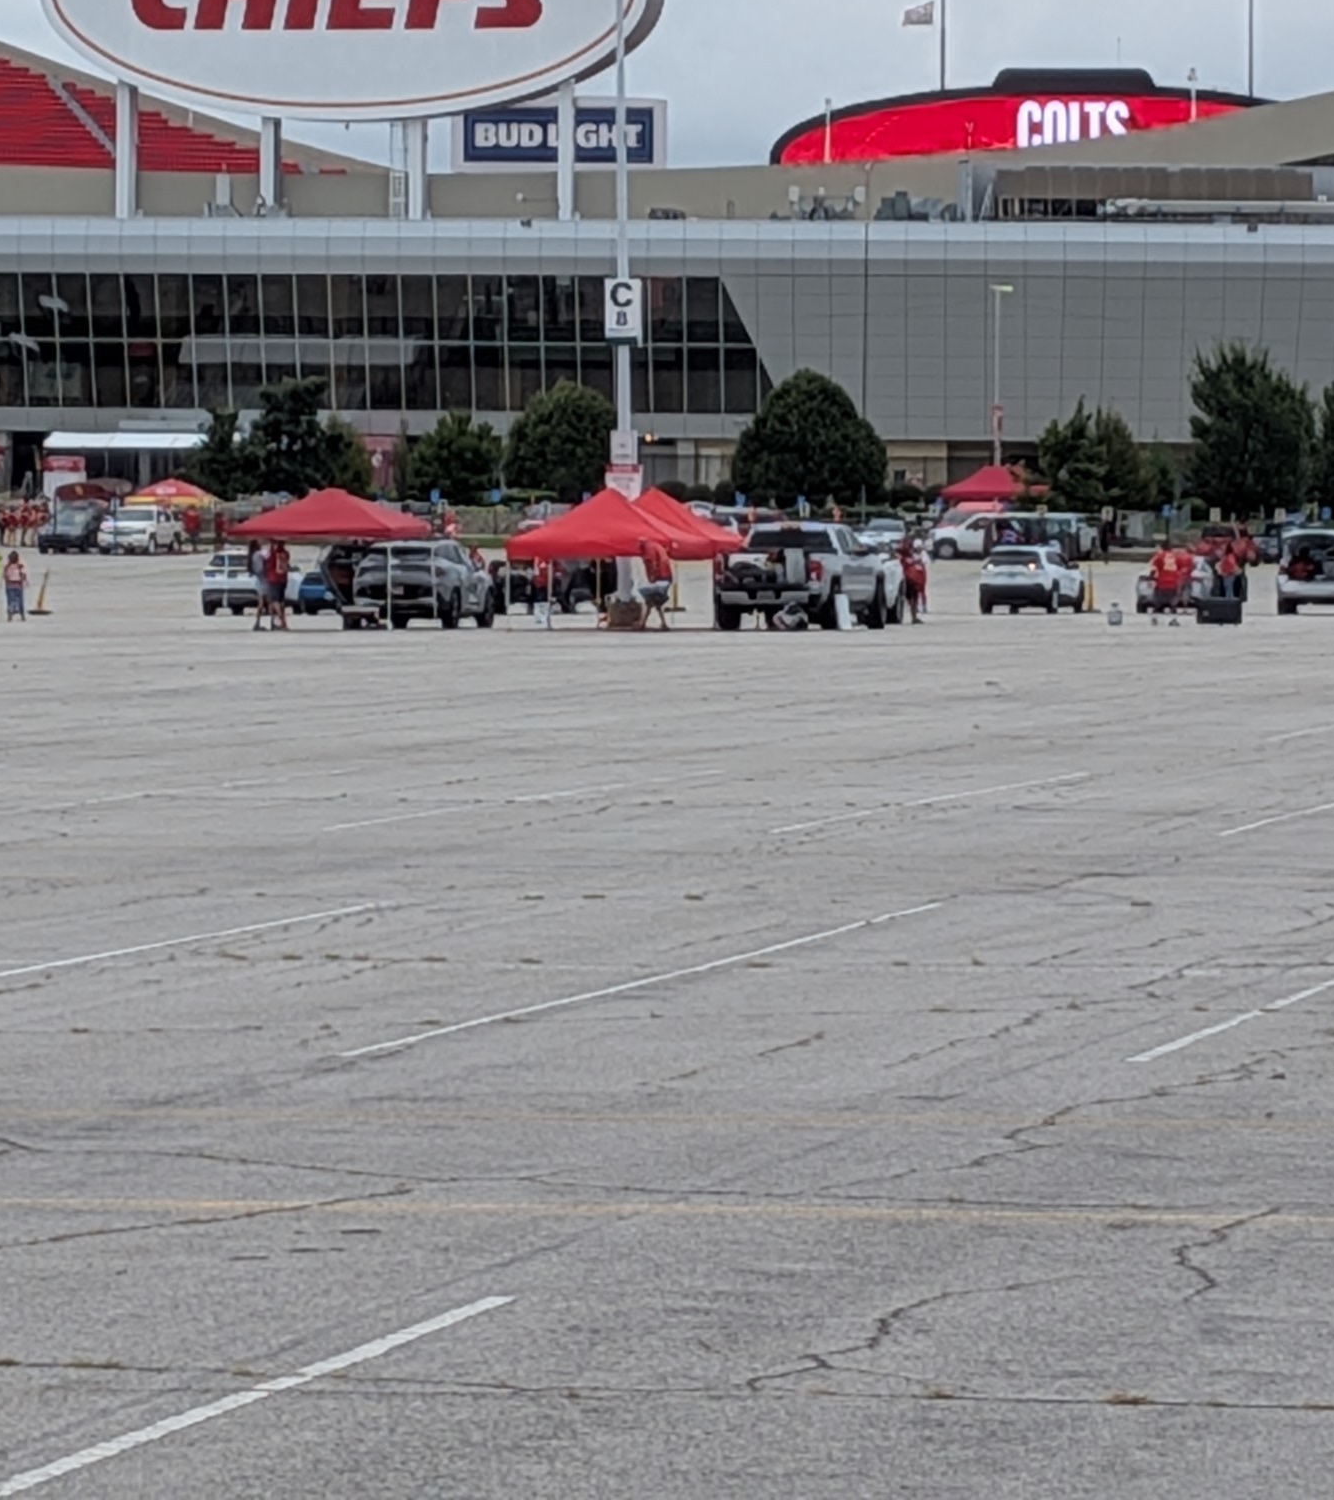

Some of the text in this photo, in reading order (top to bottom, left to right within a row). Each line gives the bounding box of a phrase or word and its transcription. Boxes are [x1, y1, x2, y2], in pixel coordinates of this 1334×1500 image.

[474, 121, 643, 149] BUD LGHT
[610, 282, 633, 307] C
